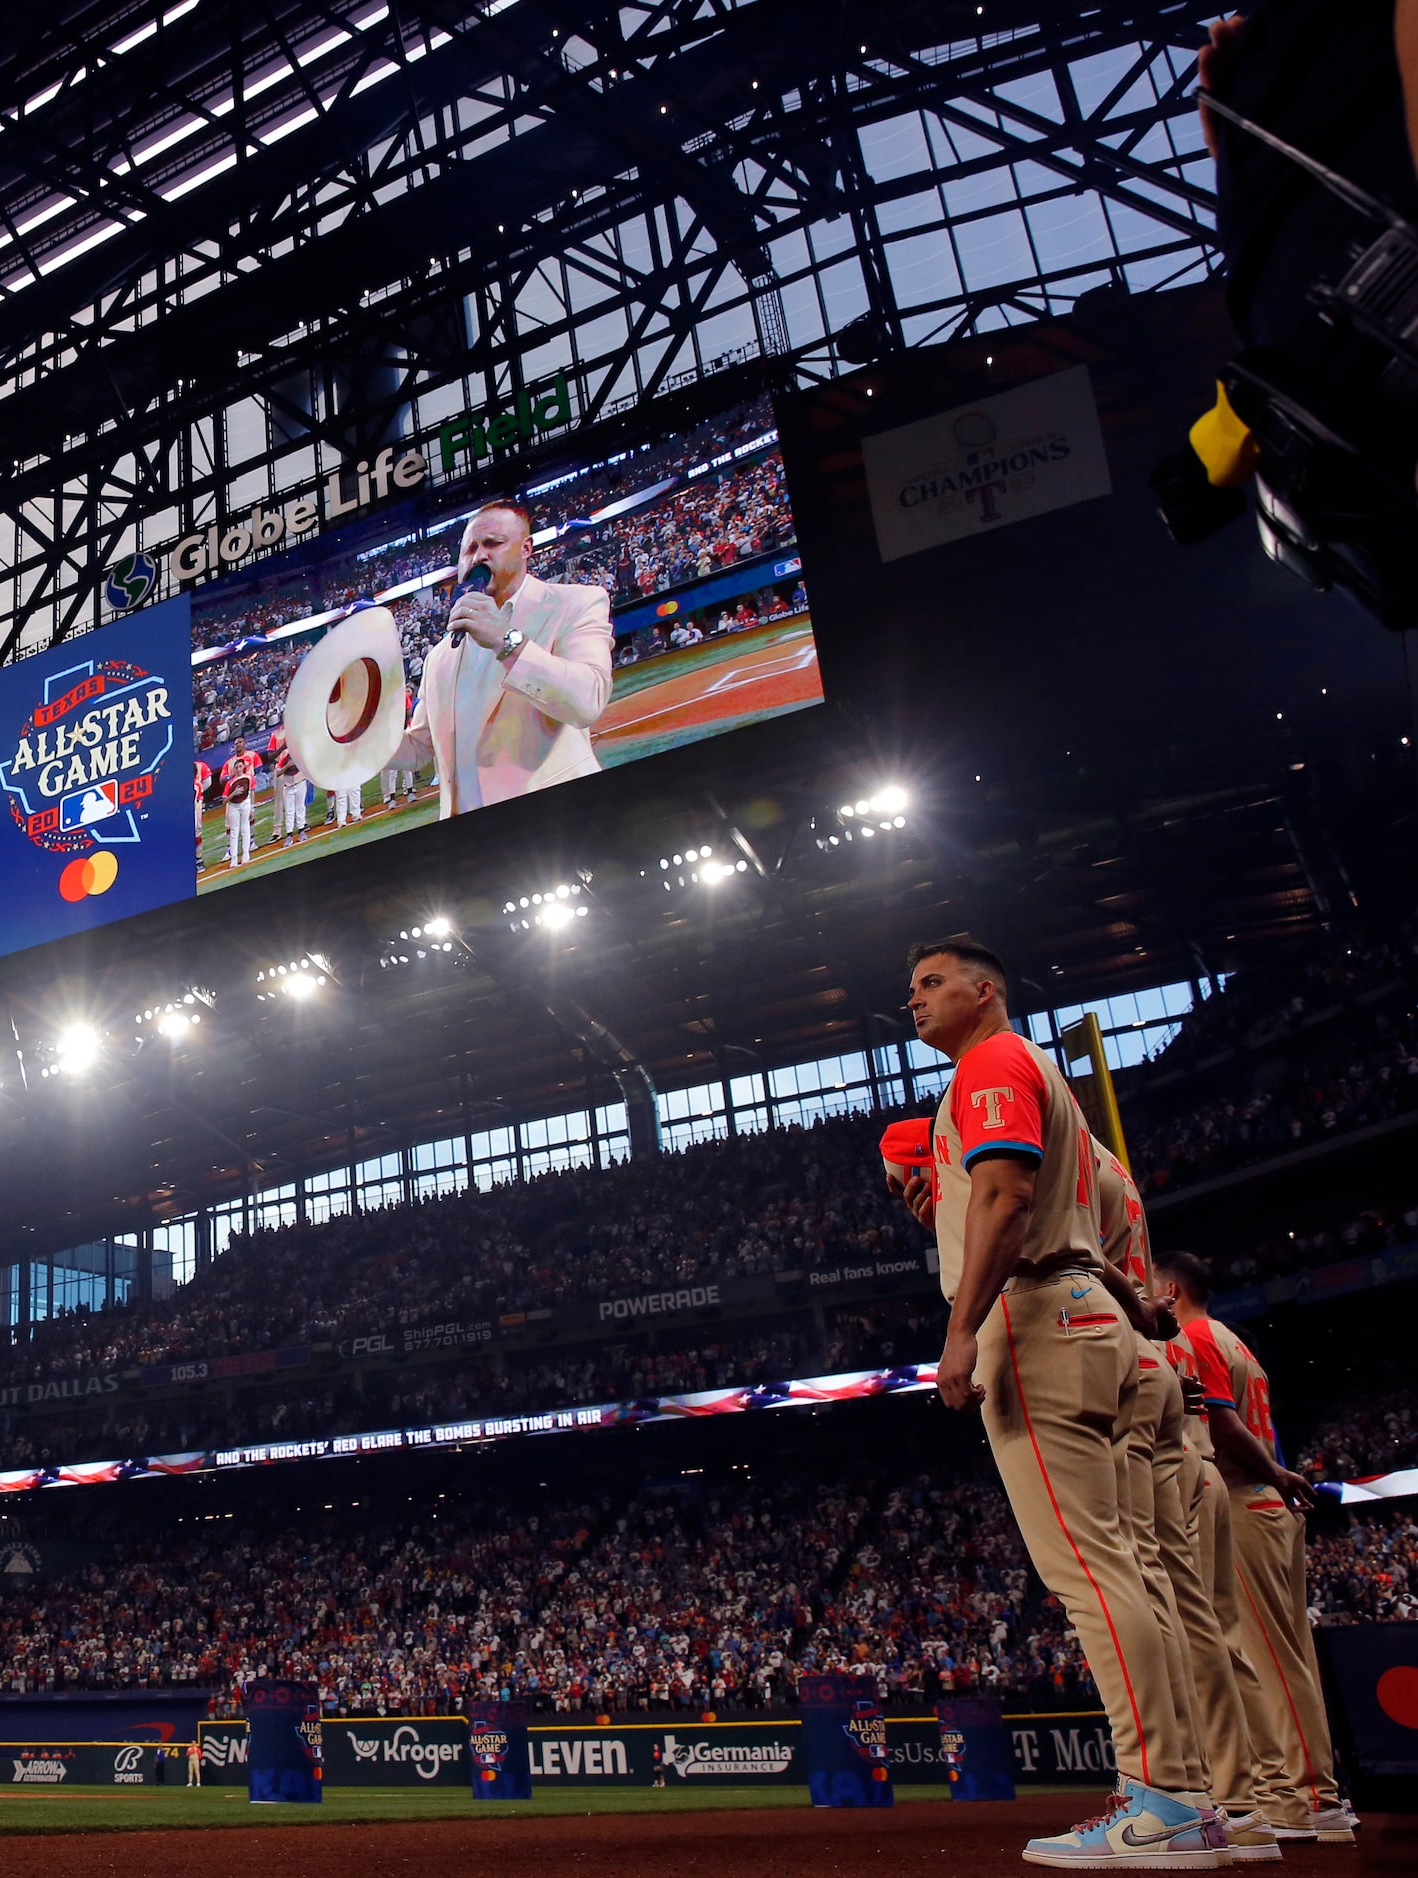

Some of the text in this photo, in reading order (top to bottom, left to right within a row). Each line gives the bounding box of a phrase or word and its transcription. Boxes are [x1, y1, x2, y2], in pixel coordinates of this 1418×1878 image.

[171, 373, 571, 580] Globe Life Field
[687, 462, 710, 479] AND
[711, 452, 733, 467] THE
[899, 437, 1071, 508] CHAMPIONS
[769, 610, 794, 622] Globe
[41, 680, 98, 723] TEXAS
[38, 734, 141, 797] GAME
[32, 783, 147, 831] 20 24
[971, 1086, 1015, 1130] T
[810, 1259, 921, 1286] Real fans know.
[600, 1285, 720, 1320] POWERADE
[352, 1334, 394, 1354] PGL
[403, 1321, 491, 1341] ShipPGL.com
[171, 1363, 208, 1382] 105.3
[28, 1374, 118, 1401] DALLAS
[216, 1409, 602, 1466] AND THE ROCKETS' RED GLARE THE BOMBS BURSTING IN AIR
[384, 1726, 463, 1779] Kroger
[475, 1743, 500, 1754] GAME
[694, 1742, 792, 1761] Germania
[26, 1761, 60, 1775] ARROW
[114, 1773, 144, 1783] SPORTS
[702, 1763, 776, 1772] INSURANCE
